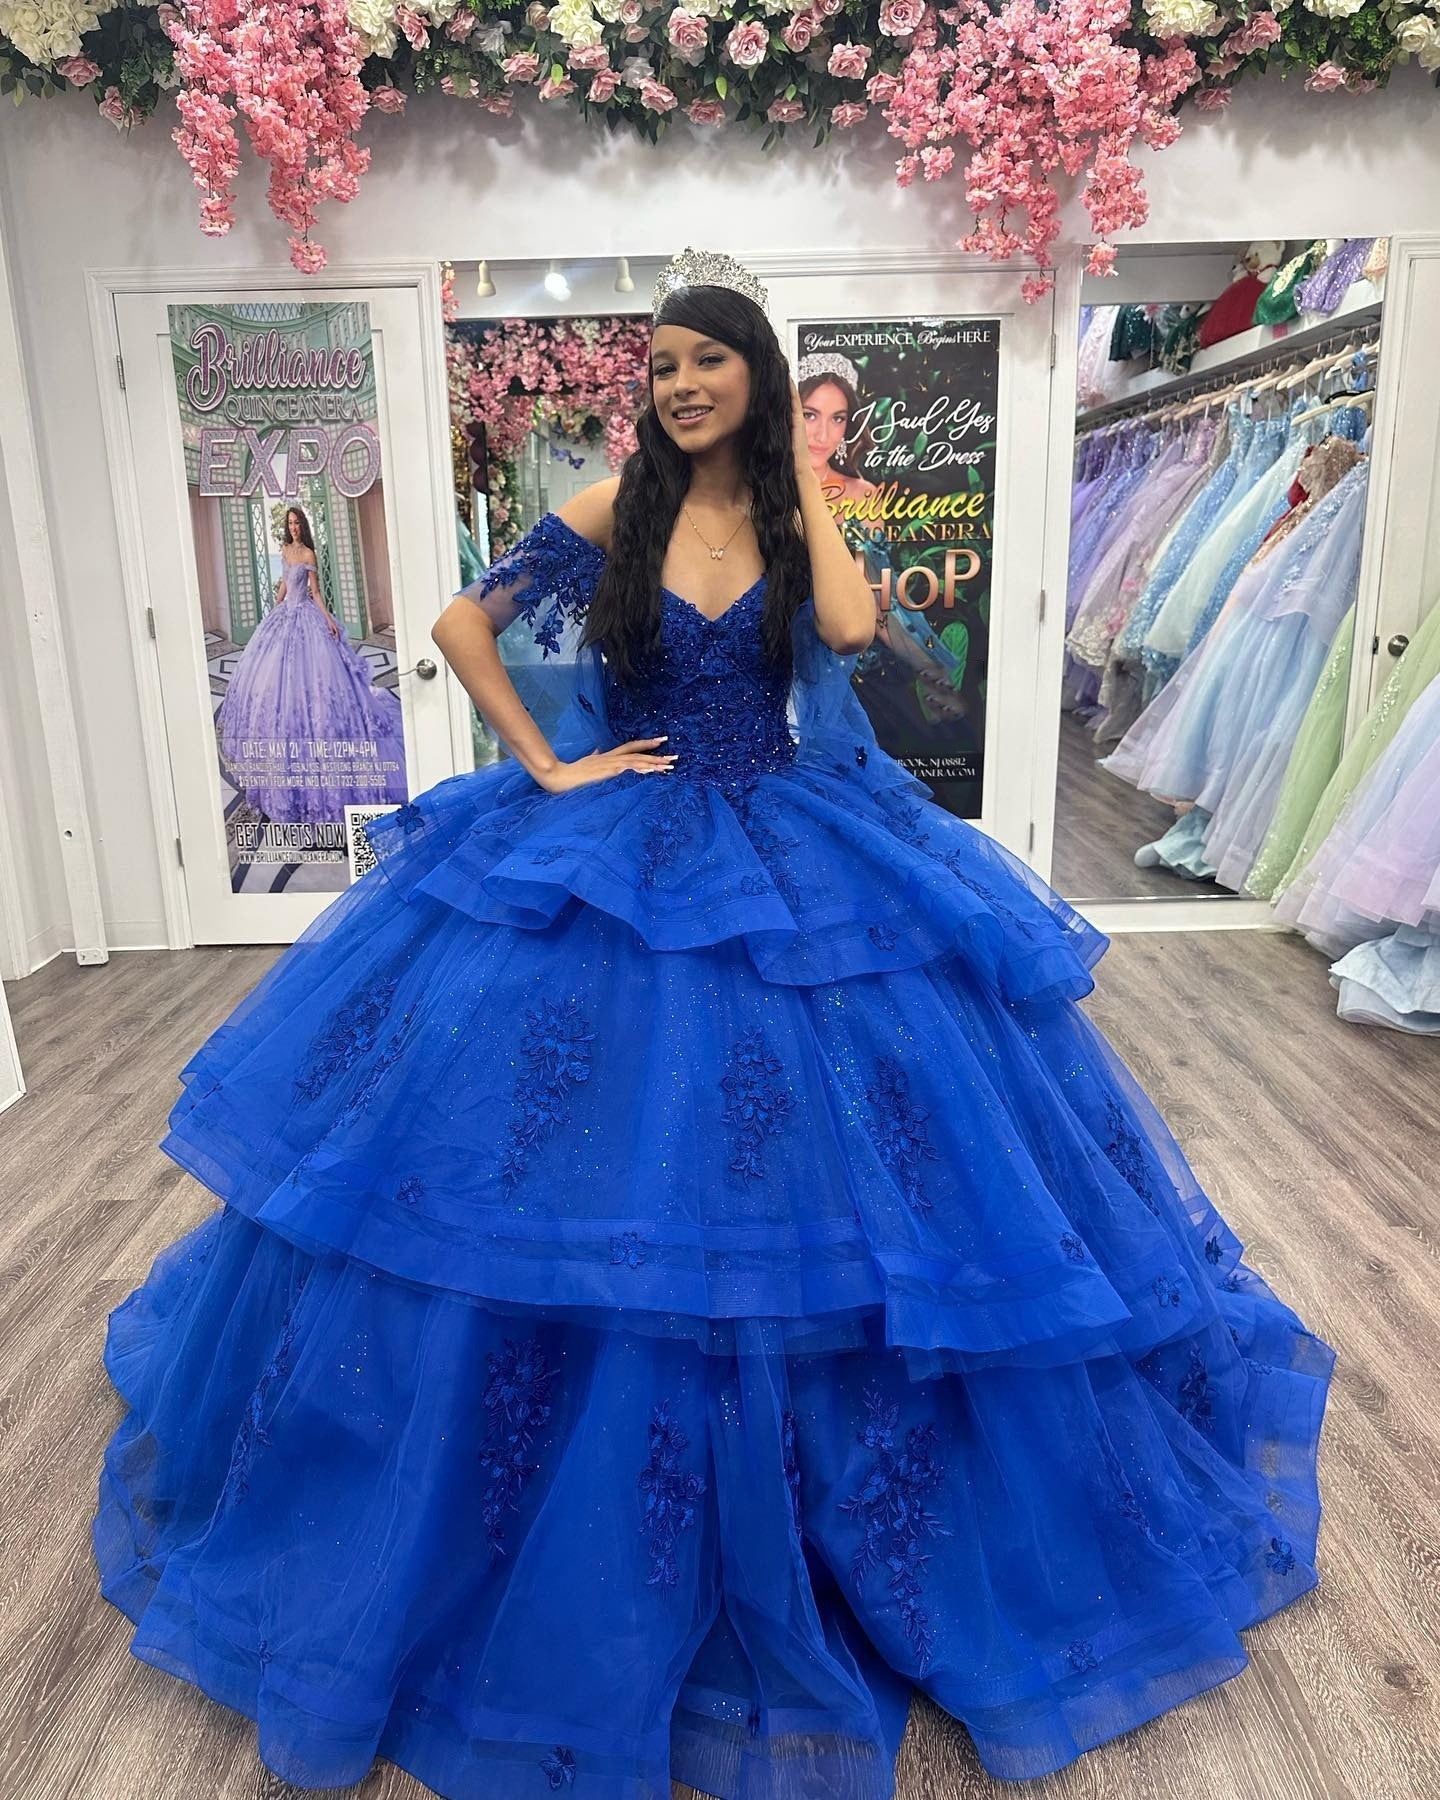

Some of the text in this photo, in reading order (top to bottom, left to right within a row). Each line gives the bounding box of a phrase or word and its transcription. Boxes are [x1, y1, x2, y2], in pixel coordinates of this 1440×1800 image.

[804, 330, 991, 351] Your EXPERIENCE Begins HERE
[186, 323, 365, 411] Brilliance
[870, 396, 949, 443] Said
[945, 399, 995, 440] Yes
[199, 424, 381, 498] EXPO
[863, 441, 986, 471] to the Dress
[855, 549, 981, 611] HOP
[269, 741, 286, 758] MAY
[290, 741, 299, 758] 21
[235, 823, 345, 848] GET TICKETS NOW
